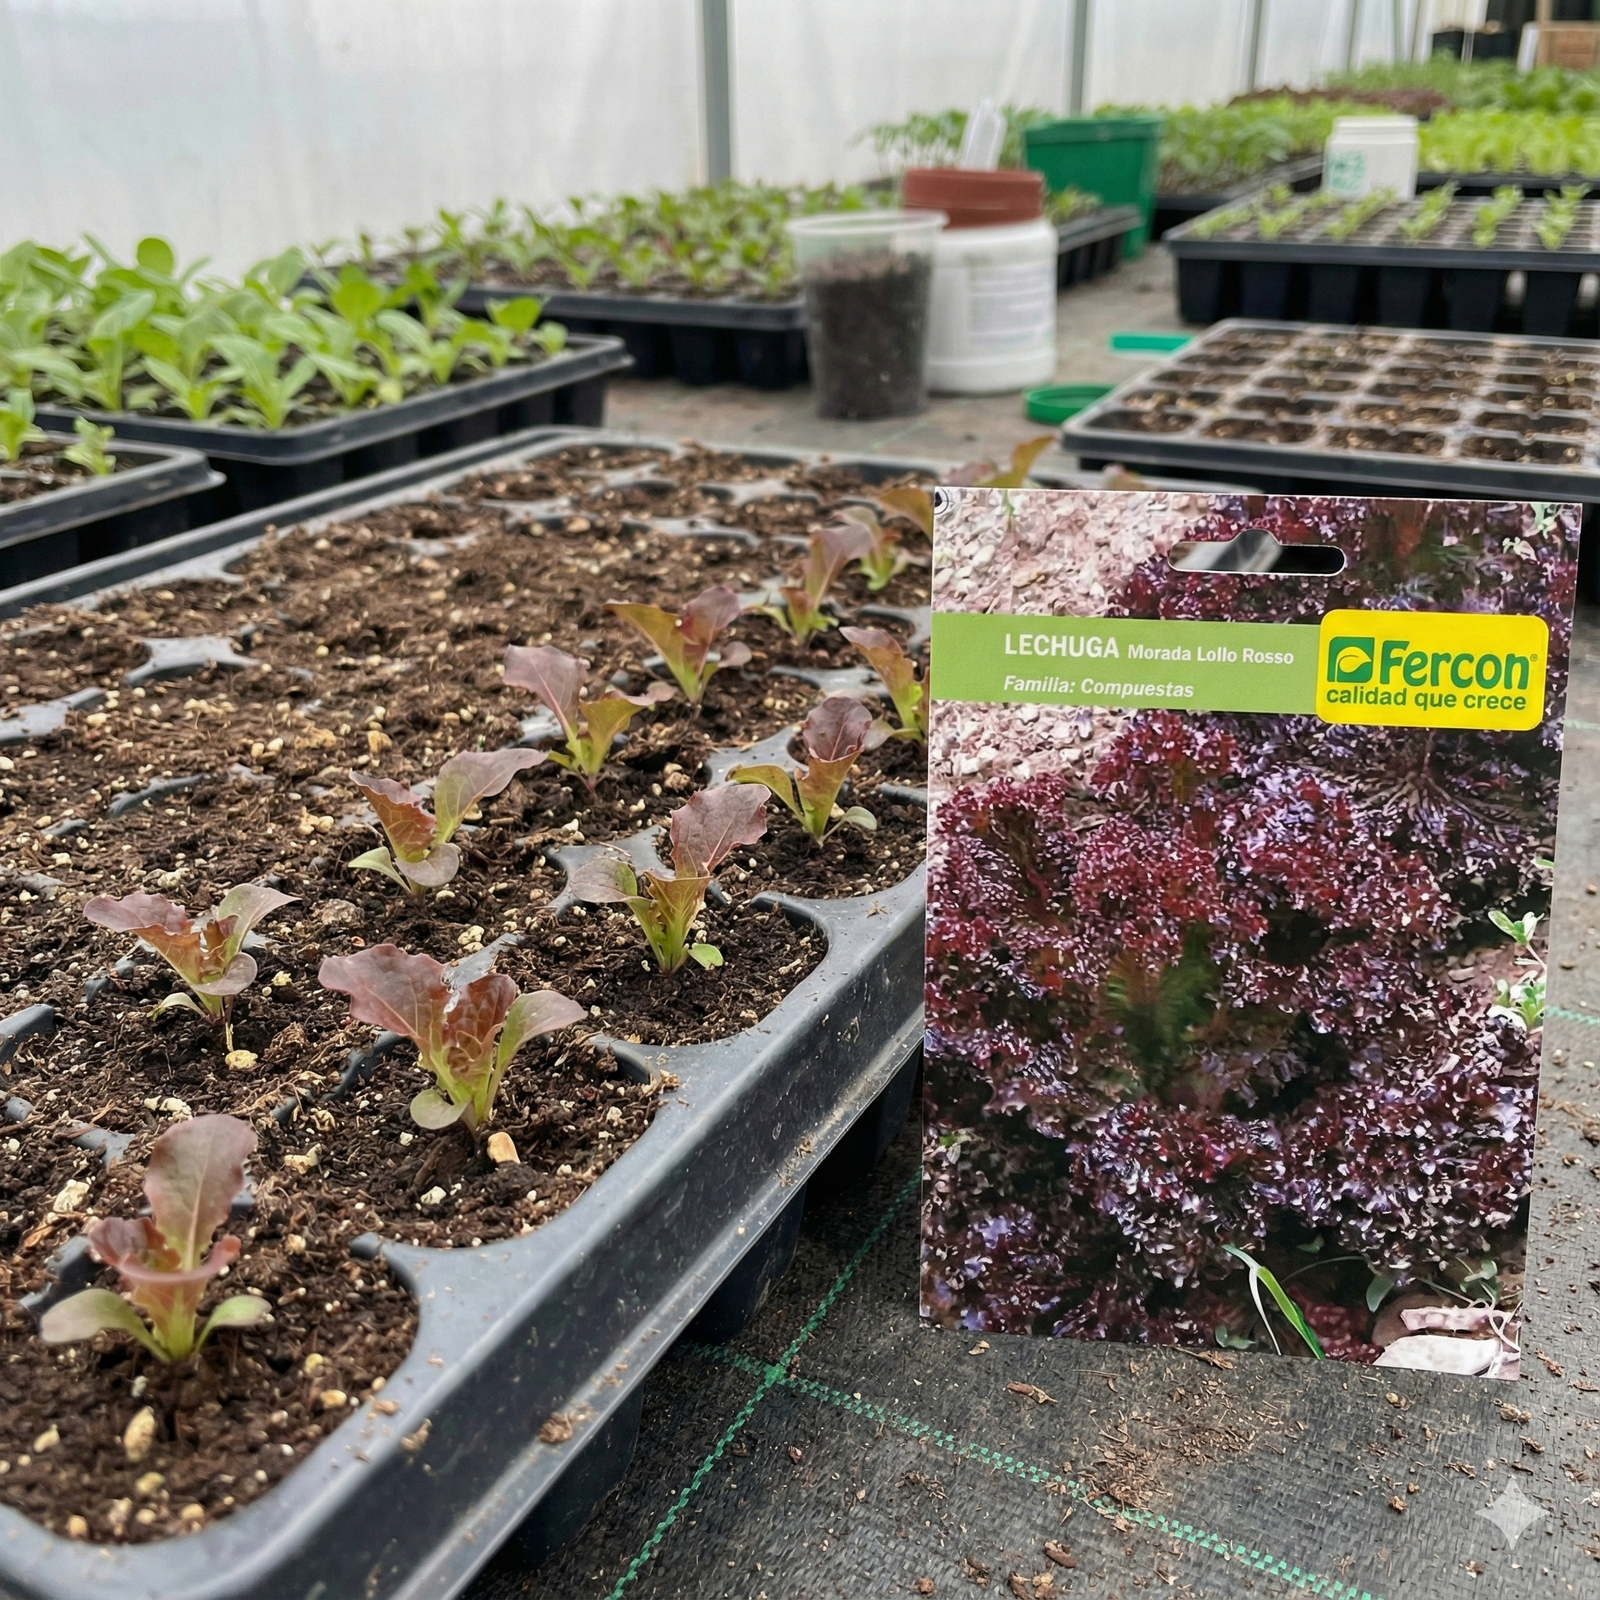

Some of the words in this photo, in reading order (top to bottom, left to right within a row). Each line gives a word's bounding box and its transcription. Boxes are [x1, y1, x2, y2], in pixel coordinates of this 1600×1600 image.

[1004, 633, 1120, 659] LECHUGA
[1128, 644, 1192, 661] Morada
[1197, 646, 1238, 663] Lollo
[1242, 648, 1294, 665] Rosso
[1003, 675, 1076, 693] Familia:
[1080, 678, 1194, 699] Compuestas
[1326, 686, 1408, 706] calidad
[1414, 692, 1457, 712] que
[1463, 694, 1527, 711] crece
